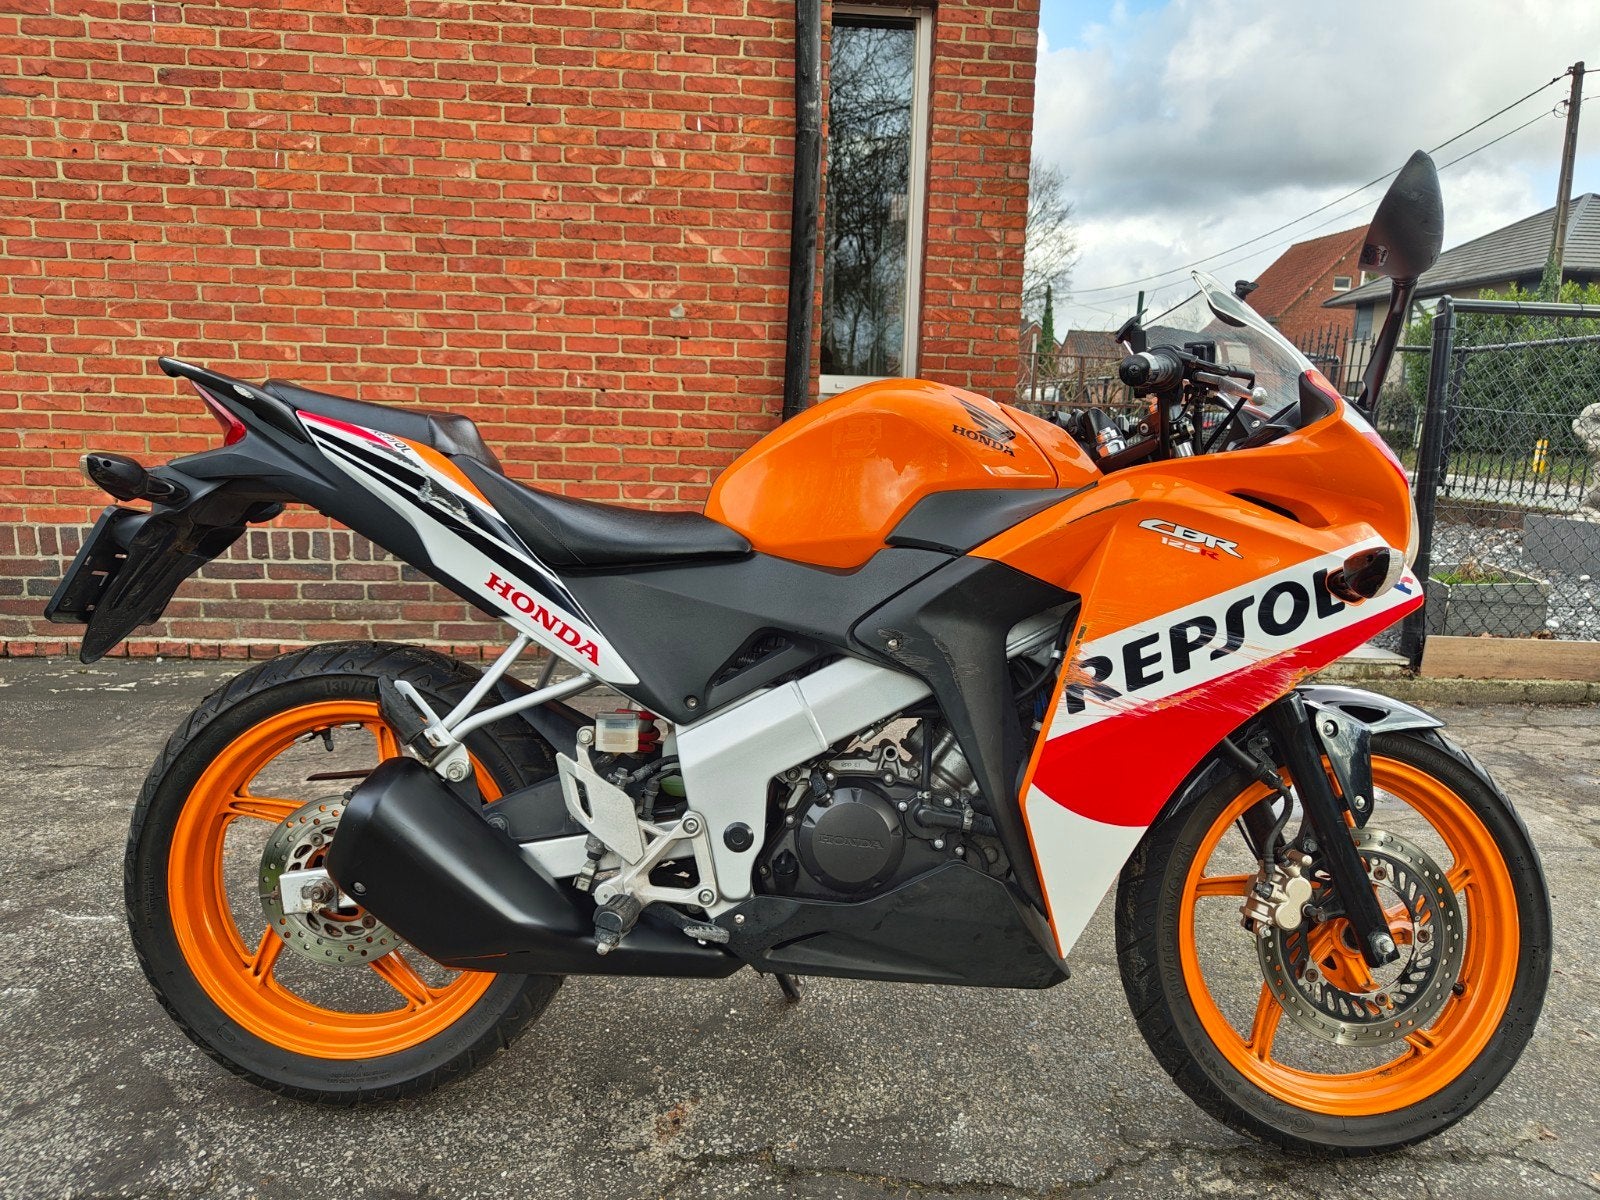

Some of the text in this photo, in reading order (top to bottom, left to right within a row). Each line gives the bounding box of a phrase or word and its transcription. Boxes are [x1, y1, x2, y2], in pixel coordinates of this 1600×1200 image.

[952, 423, 1016, 458] HONDA
[1138, 517, 1244, 559] CBR
[1161, 536, 1219, 561] 125R
[484, 572, 600, 667] HONDA
[1064, 567, 1347, 715] REPSOL
[818, 833, 885, 850] HONDA
